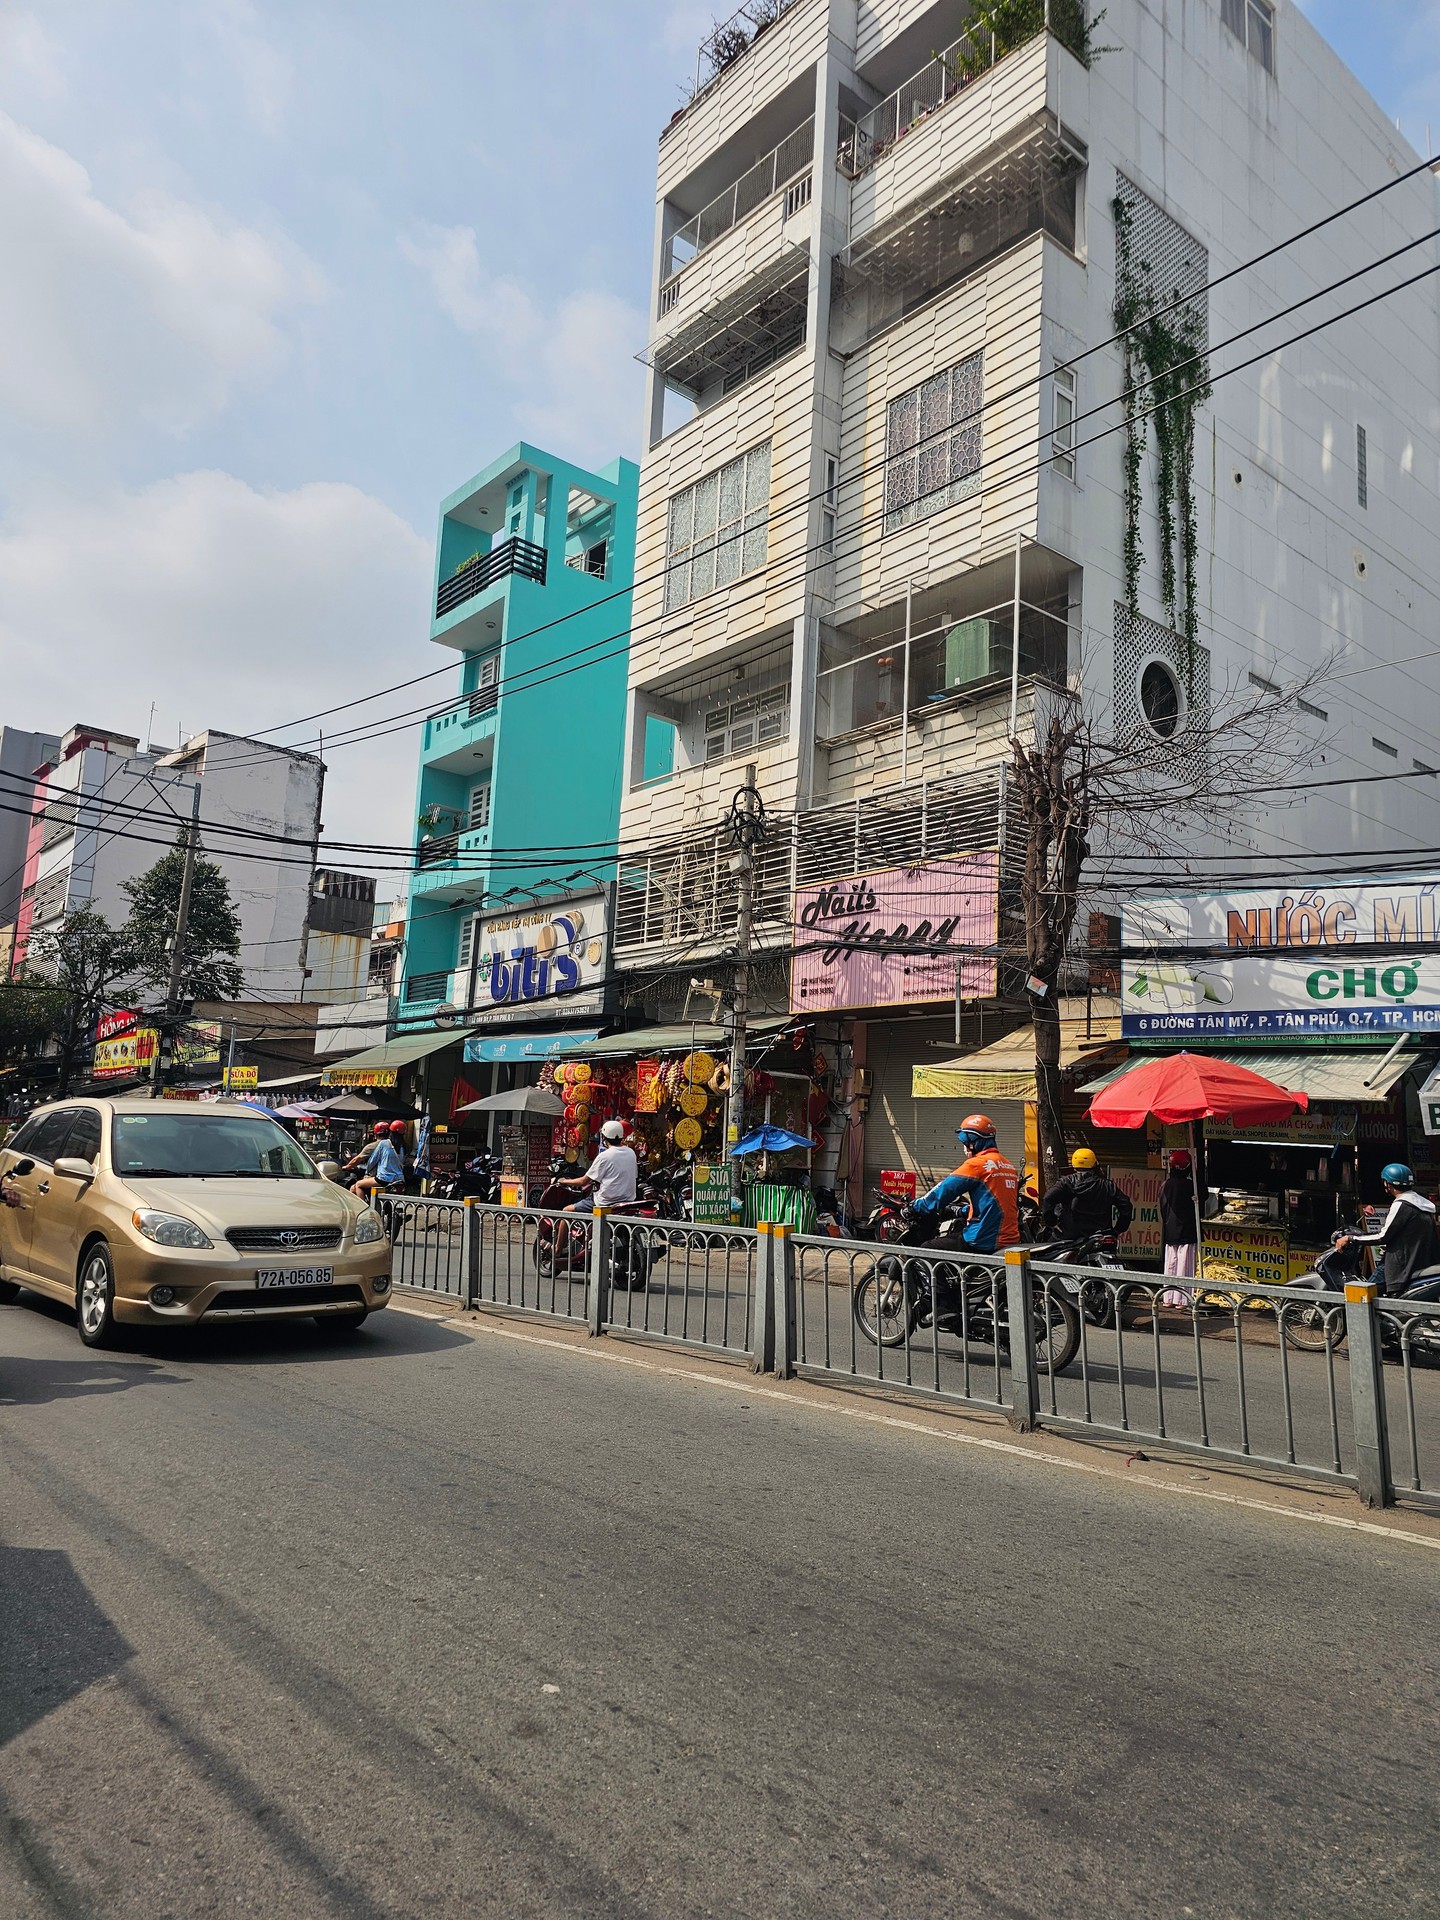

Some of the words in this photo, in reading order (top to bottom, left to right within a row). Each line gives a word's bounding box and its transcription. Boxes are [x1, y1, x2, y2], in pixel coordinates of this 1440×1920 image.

[801, 879, 877, 926] Nails
[1227, 891, 1356, 947] NƯỚC
[1373, 884, 1440, 944] MÍ
[823, 915, 961, 966] Happy
[1306, 960, 1423, 1004] CHỢ
[1139, 1019, 1148, 1030] 6
[1151, 1014, 1195, 1030] ĐƯỜNG
[1198, 1014, 1226, 1029] TÂN
[1229, 1012, 1254, 1031] MỸ,
[1259, 1016, 1272, 1028] P.
[1276, 1011, 1305, 1026] TÂN
[1309, 1010, 1344, 1028] PHÚ,
[1348, 1011, 1378, 1027] Q.7,
[1382, 1011, 1407, 1024] TP.
[432, 1135, 444, 1144] BÚN
[446, 1135, 456, 1144] BÒ
[709, 1166, 729, 1186] SỬA
[718, 1188, 729, 1201] ÁO
[696, 1203, 707, 1216] TÚI
[709, 1202, 730, 1215] XÁCH
[1140, 1204, 1159, 1223] MÁ
[1137, 1225, 1161, 1246] TẮC
[1202, 1226, 1244, 1244] NƯỚC
[1250, 1231, 1281, 1248] MÍA
[1245, 1248, 1285, 1265] THỐNG
[1300, 1252, 1317, 1262] NGUYÊ
[261, 1267, 332, 1288] 72A-056.85
[1256, 1264, 1282, 1281] BÉO
